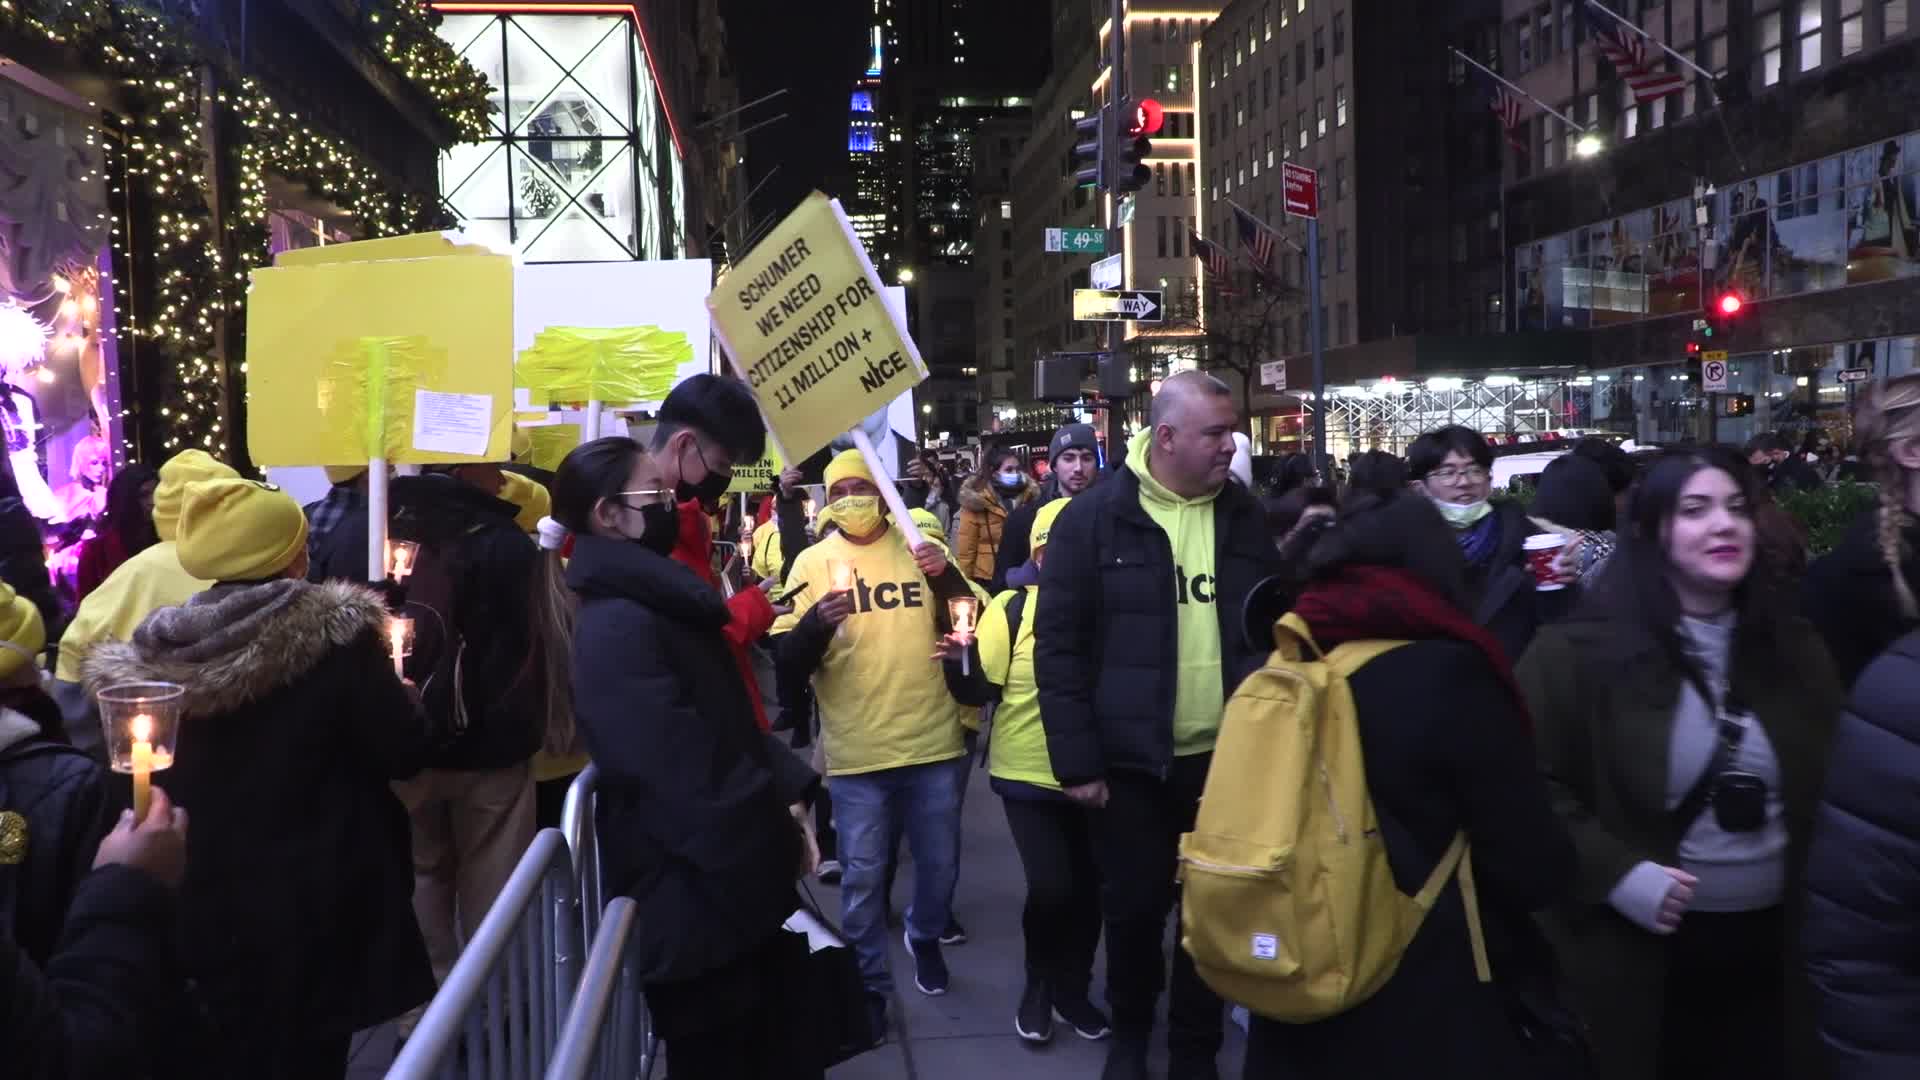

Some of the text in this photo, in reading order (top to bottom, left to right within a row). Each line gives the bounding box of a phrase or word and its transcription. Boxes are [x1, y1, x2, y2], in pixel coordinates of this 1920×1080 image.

[1062, 232, 1069, 249] E
[1073, 232, 1090, 249] 49
[738, 237, 811, 311] SCHUMER
[756, 273, 822, 337] WE NEED
[1123, 300, 1148, 312] WAY
[747, 276, 875, 388] CITIZENSHIP FOR
[774, 384, 796, 410] 11
[791, 331, 860, 395] MILLION
[859, 351, 907, 393] NICE
[734, 469, 773, 478] MILIES
[754, 481, 770, 490] NIC
[1176, 565, 1216, 604] IC
